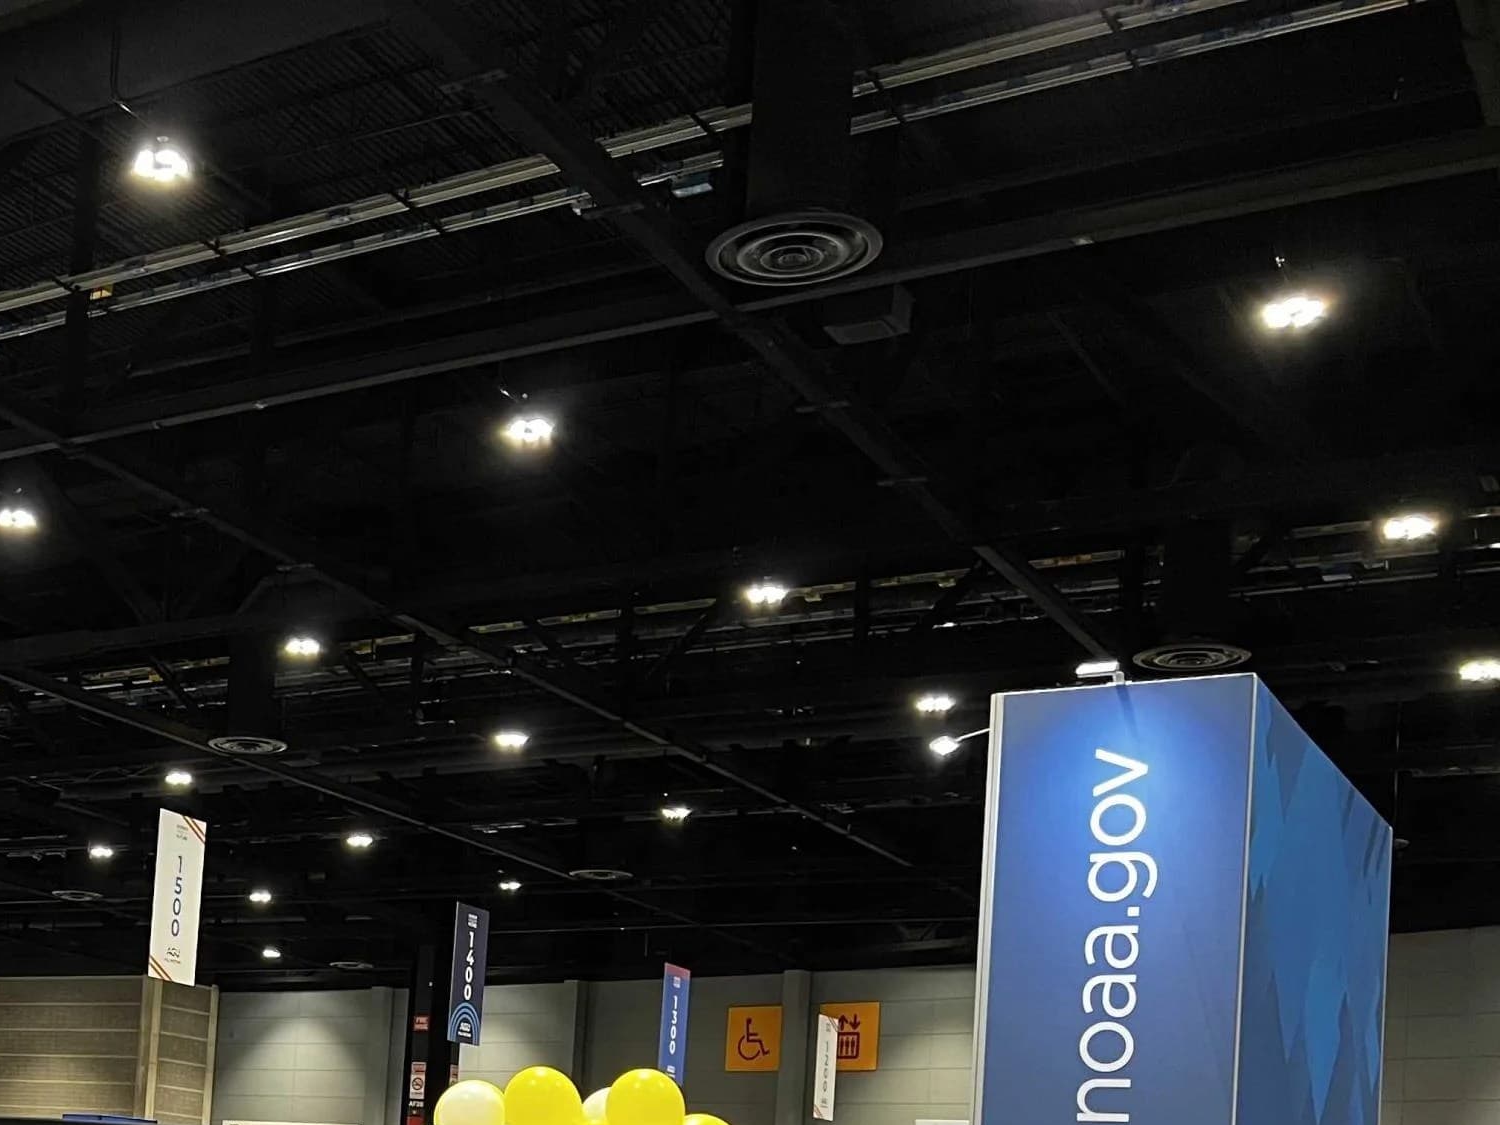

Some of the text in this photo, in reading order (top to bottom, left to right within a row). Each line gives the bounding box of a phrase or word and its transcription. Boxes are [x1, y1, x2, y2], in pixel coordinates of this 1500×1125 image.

[171, 855, 183, 936] 1500
[463, 931, 474, 1000] 1400
[1076, 748, 1158, 1123] noaa.gov
[669, 996, 678, 1055] 1300
